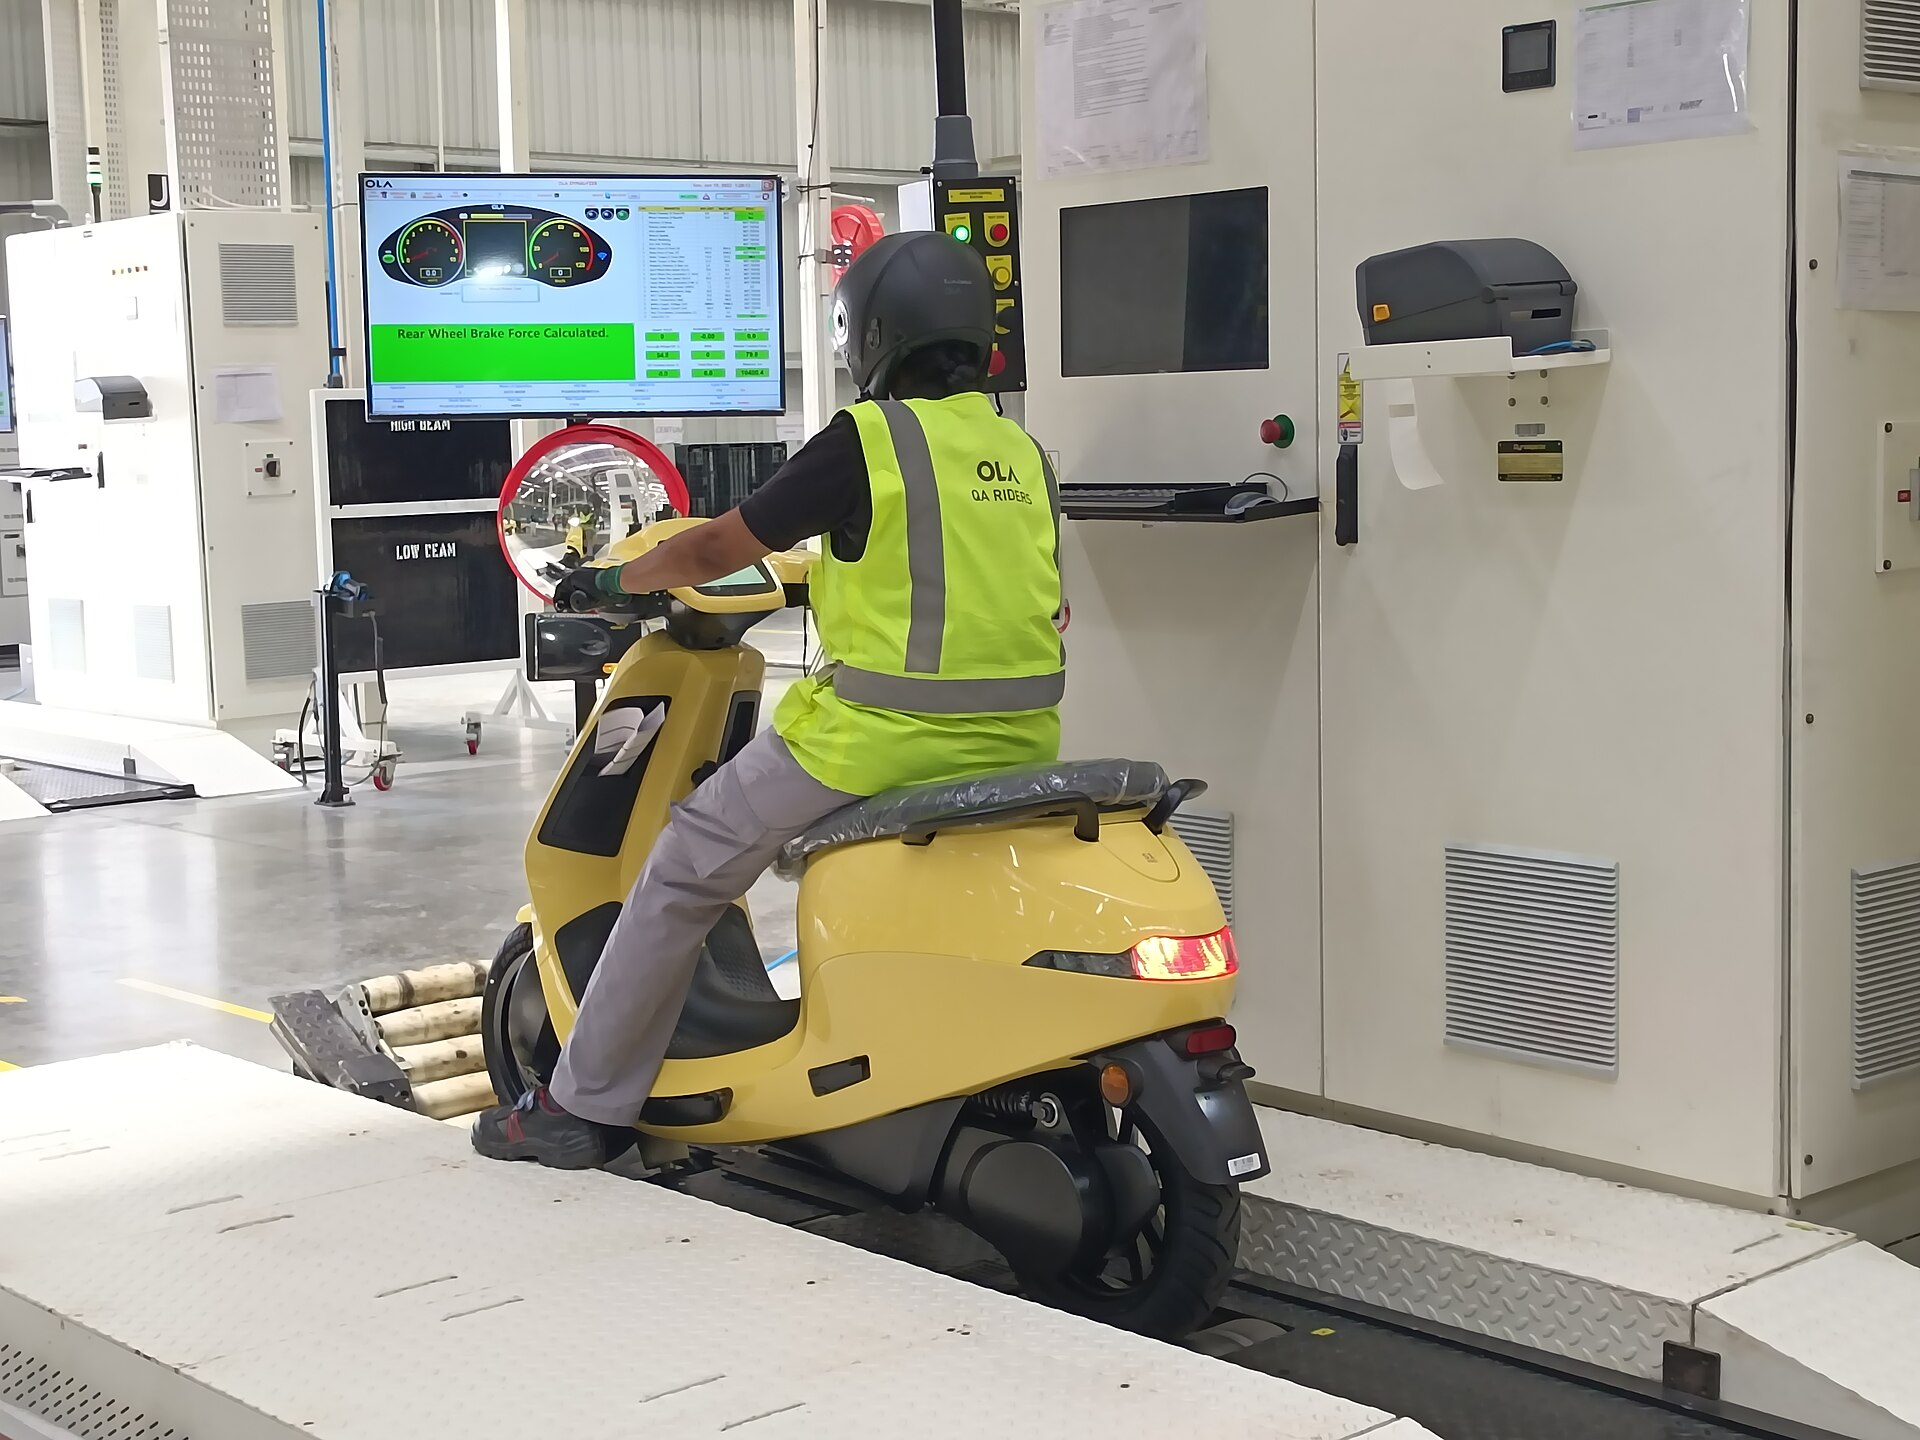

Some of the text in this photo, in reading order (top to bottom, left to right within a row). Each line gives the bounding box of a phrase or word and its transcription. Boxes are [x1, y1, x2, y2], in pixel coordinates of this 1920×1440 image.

[365, 179, 393, 188] OLA
[397, 327, 609, 339] Rear Wheel Brake Force Calculated.
[976, 460, 1020, 484] OLA
[971, 489, 1032, 505] QA RIDERS
[395, 543, 420, 560] LOW
